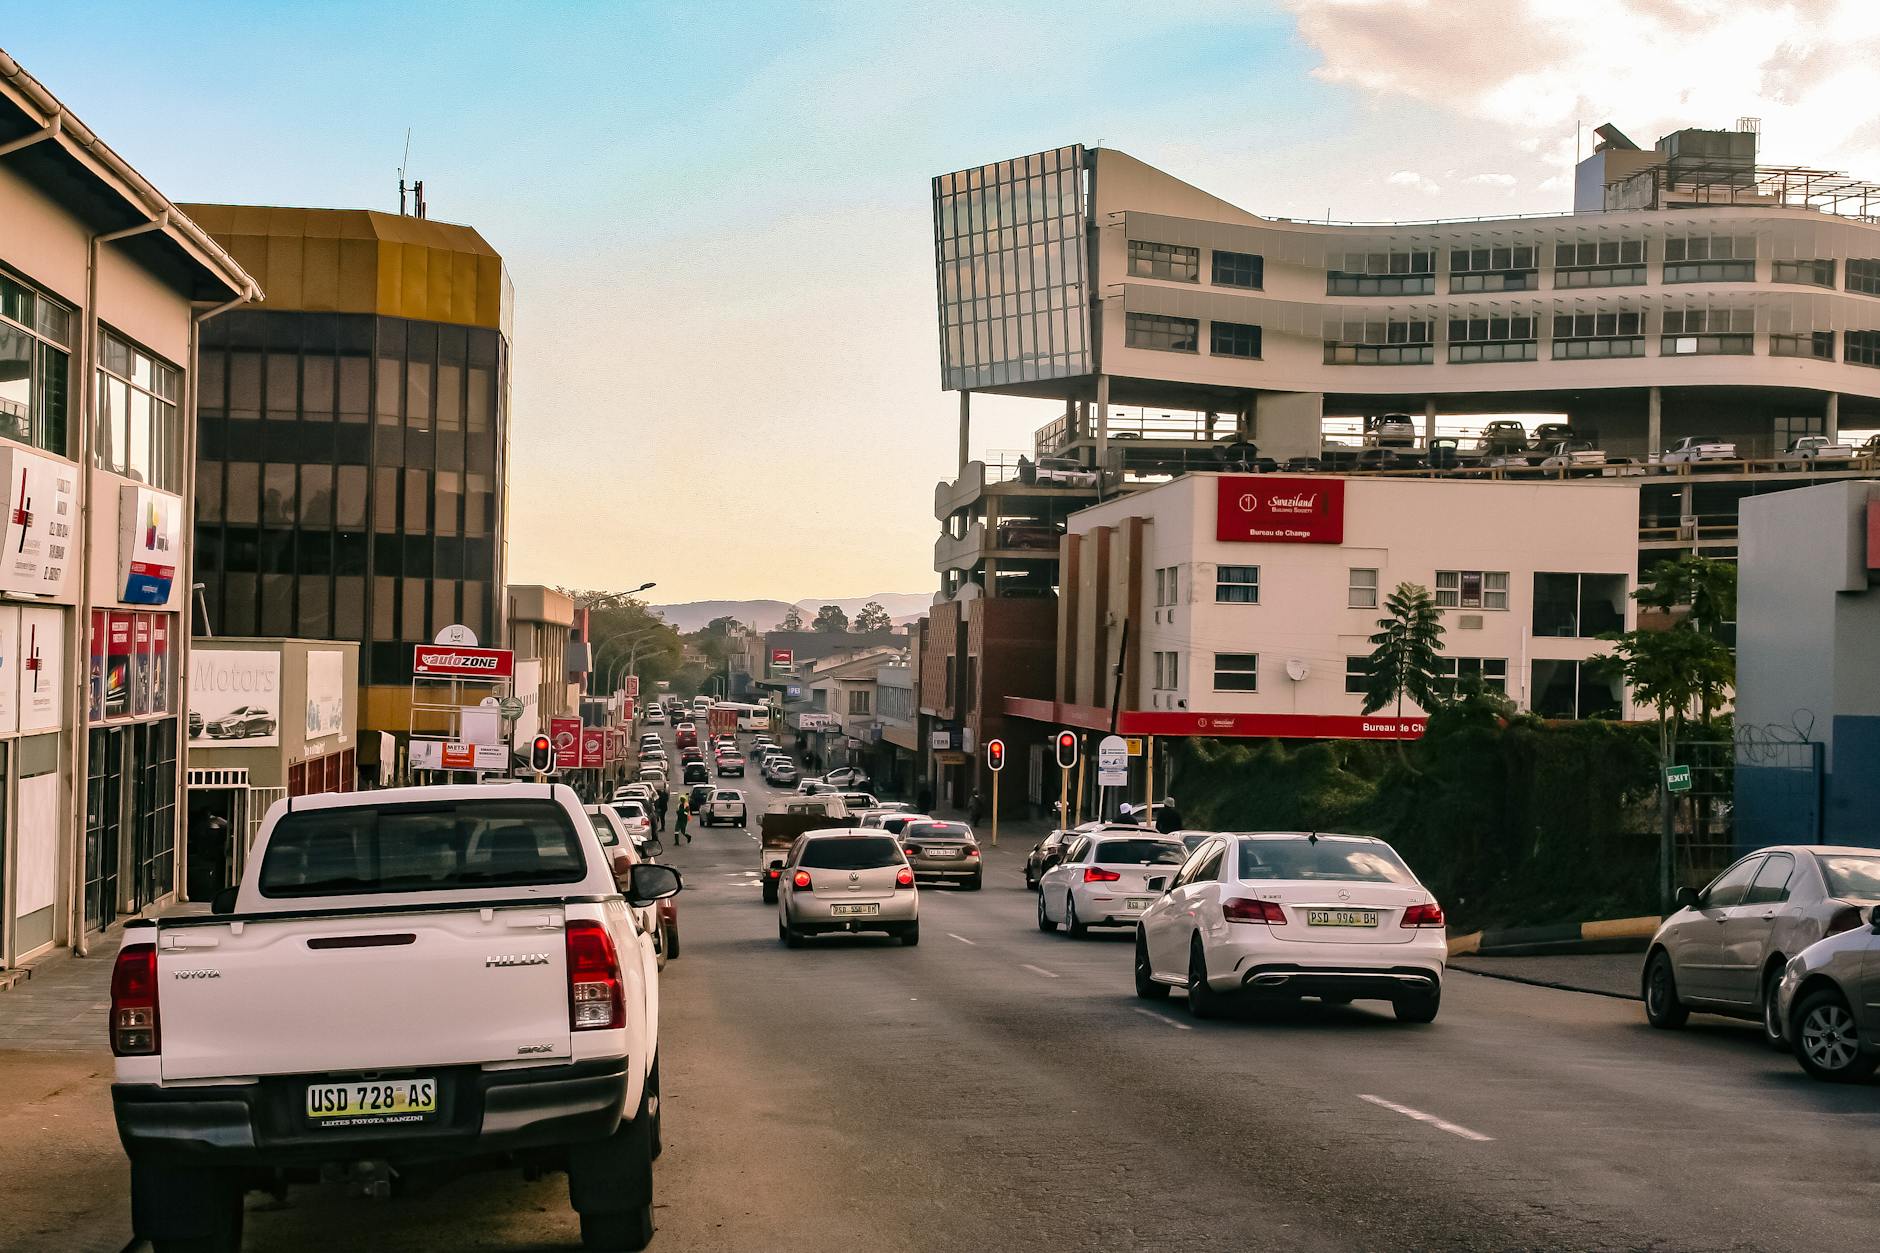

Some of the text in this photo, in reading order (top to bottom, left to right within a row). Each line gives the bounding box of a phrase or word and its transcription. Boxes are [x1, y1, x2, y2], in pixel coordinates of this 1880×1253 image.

[1268, 493, 1317, 507] Swaziland
[1285, 530, 1311, 538] Change
[194, 658, 275, 692] Motors
[1363, 723, 1396, 732] Bureau
[1668, 773, 1689, 783] EXIT
[1311, 912, 1376, 924] PSD 996 BH
[486, 953, 550, 967] HILUX
[173, 969, 221, 980] TOYOTA
[312, 1084, 432, 1112] USD 728 AS
[322, 1115, 423, 1127] LEITES TOYOTA MANZINI
